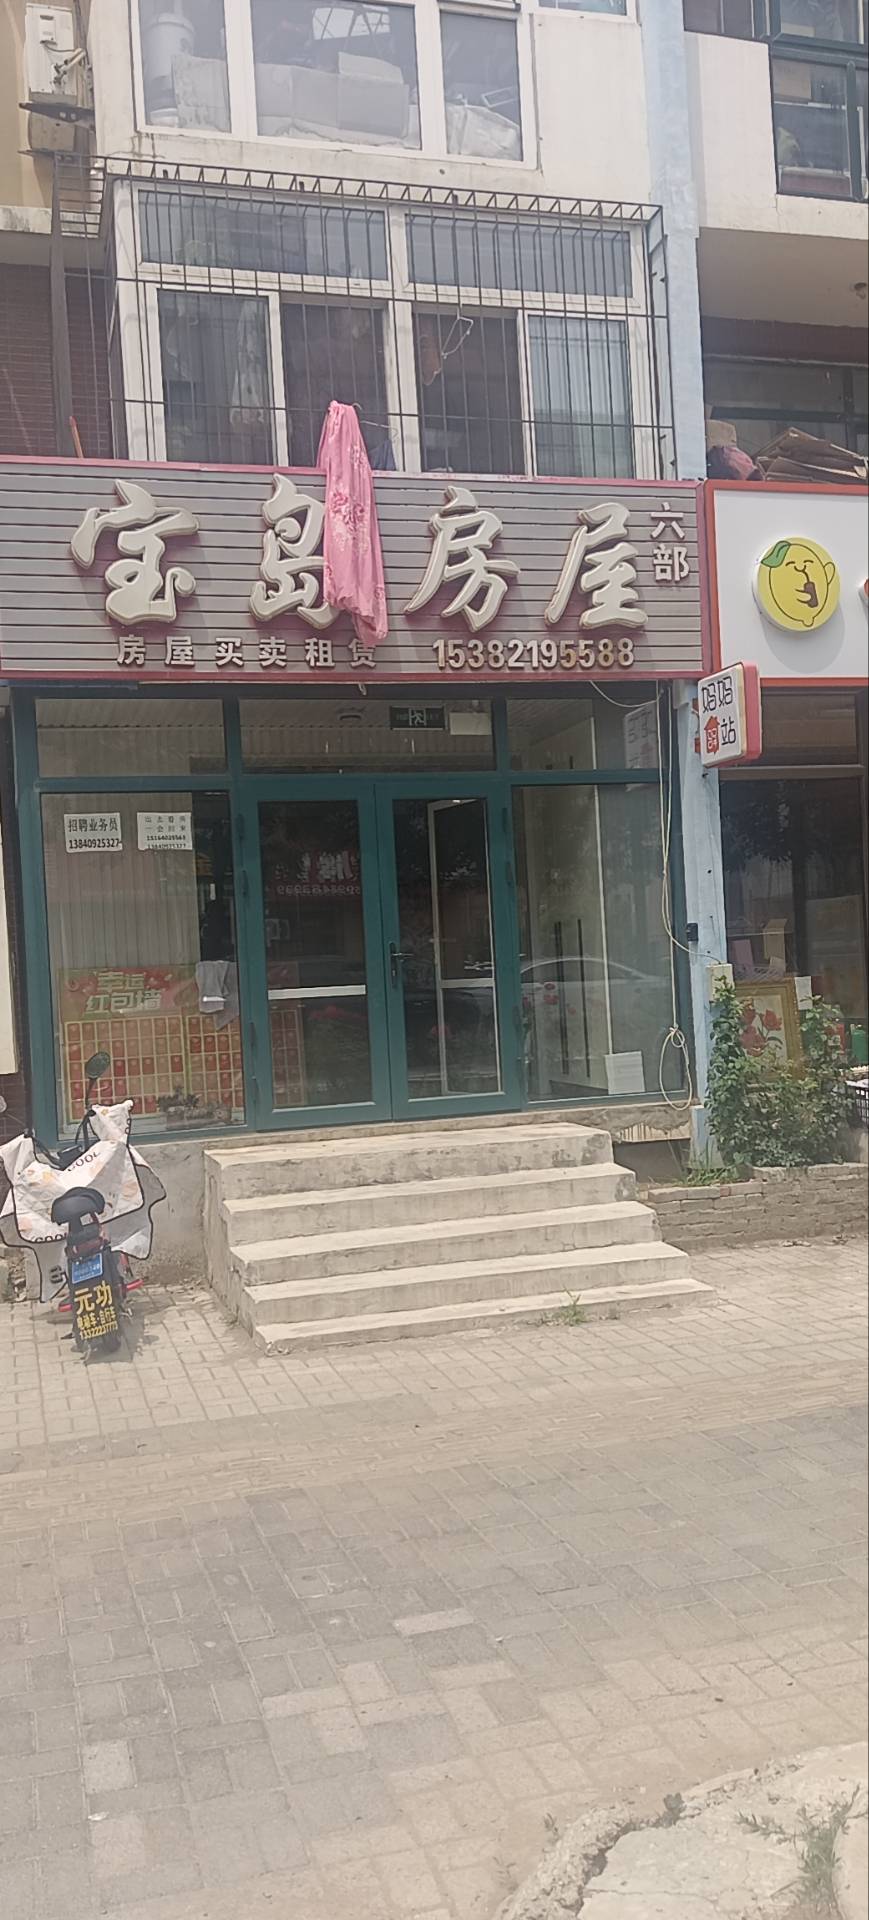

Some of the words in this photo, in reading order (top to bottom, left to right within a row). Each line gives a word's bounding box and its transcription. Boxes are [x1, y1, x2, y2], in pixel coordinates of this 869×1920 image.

[650, 501, 690, 582] 六部
[116, 634, 378, 668] 房屋买卖租赁
[432, 637, 635, 669] 15382195588
[701, 676, 734, 713] 妈妈
[68, 817, 118, 833] 招聘业务员
[97, 971, 145, 992] 幸运
[74, 1280, 112, 1314] 元功
